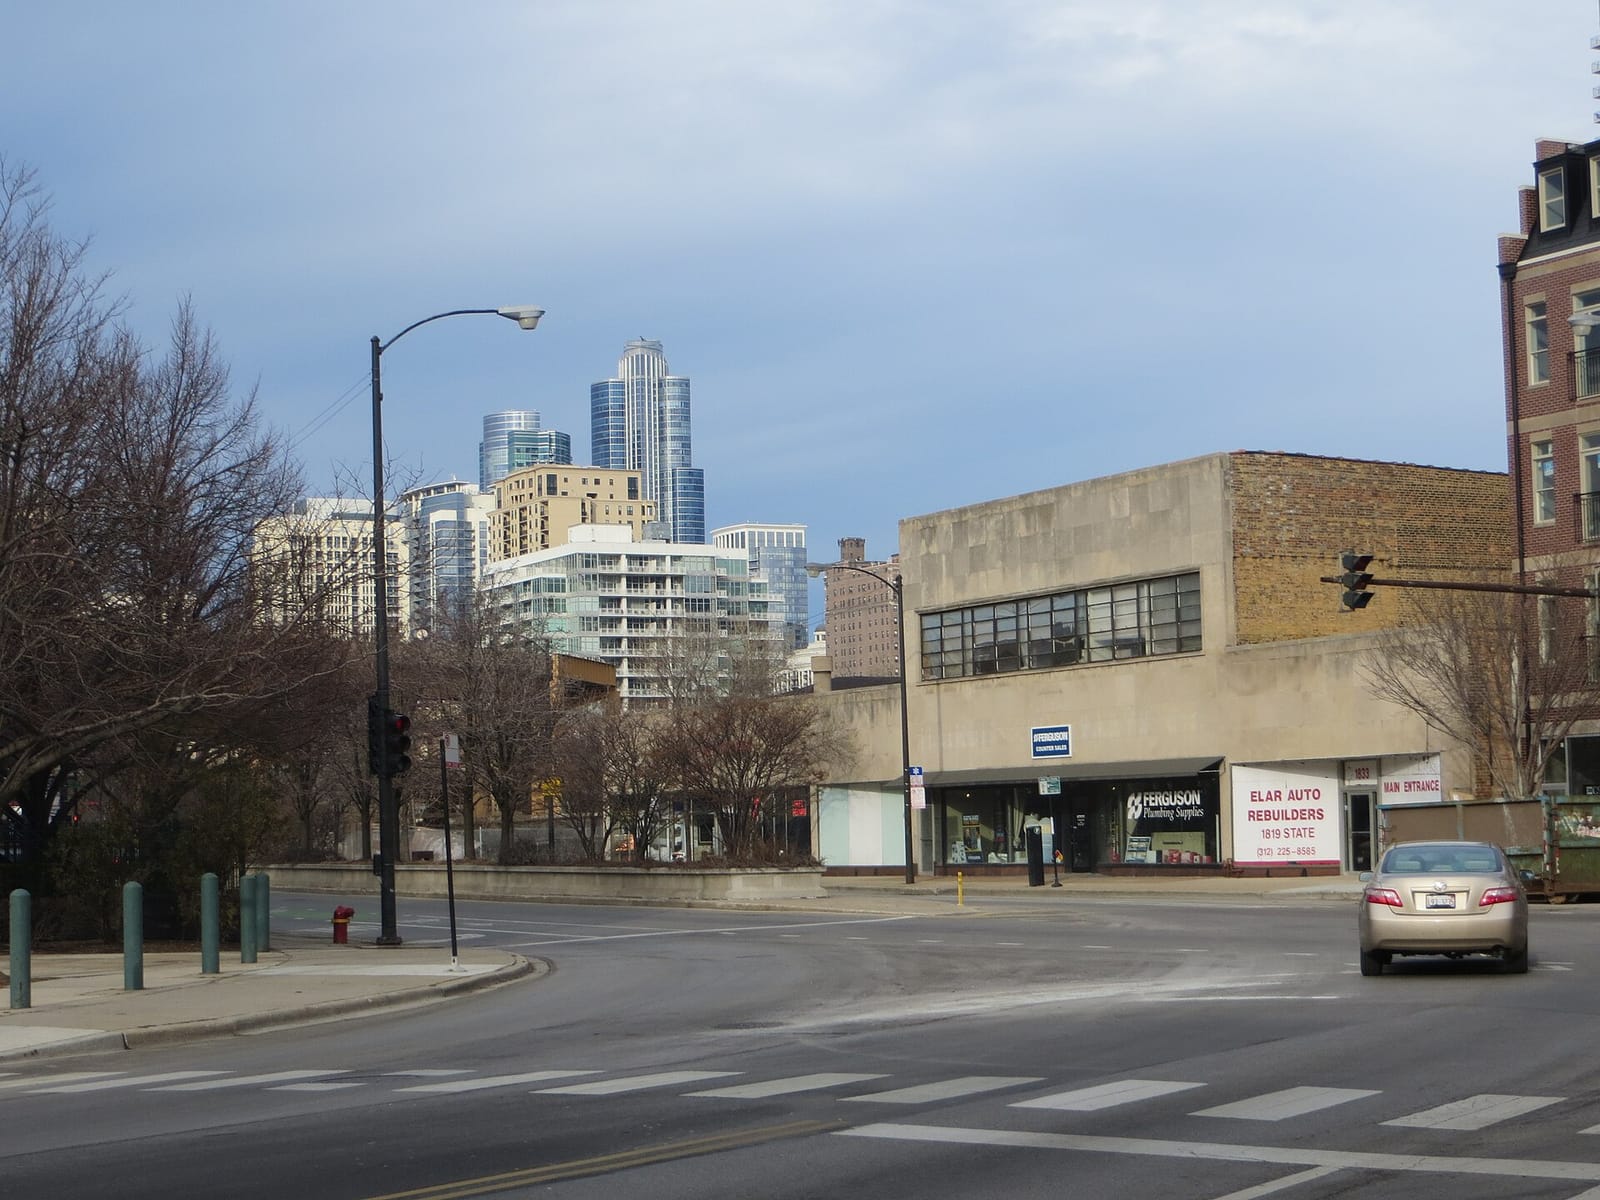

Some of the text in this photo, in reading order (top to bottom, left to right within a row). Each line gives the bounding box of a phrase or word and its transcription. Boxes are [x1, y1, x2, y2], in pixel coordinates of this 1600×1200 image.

[1355, 767, 1369, 779] 1833
[1383, 780, 1440, 793] MAIN ENTRANCE
[1143, 790, 1201, 806] FERGUSON
[1250, 788, 1321, 802] ELAR AUTO
[1143, 805, 1204, 821] Plumbing Supplies
[1247, 808, 1324, 821] REBUILDERS
[1261, 827, 1315, 839] 1819 STATE
[1256, 847, 1273, 857] (312)
